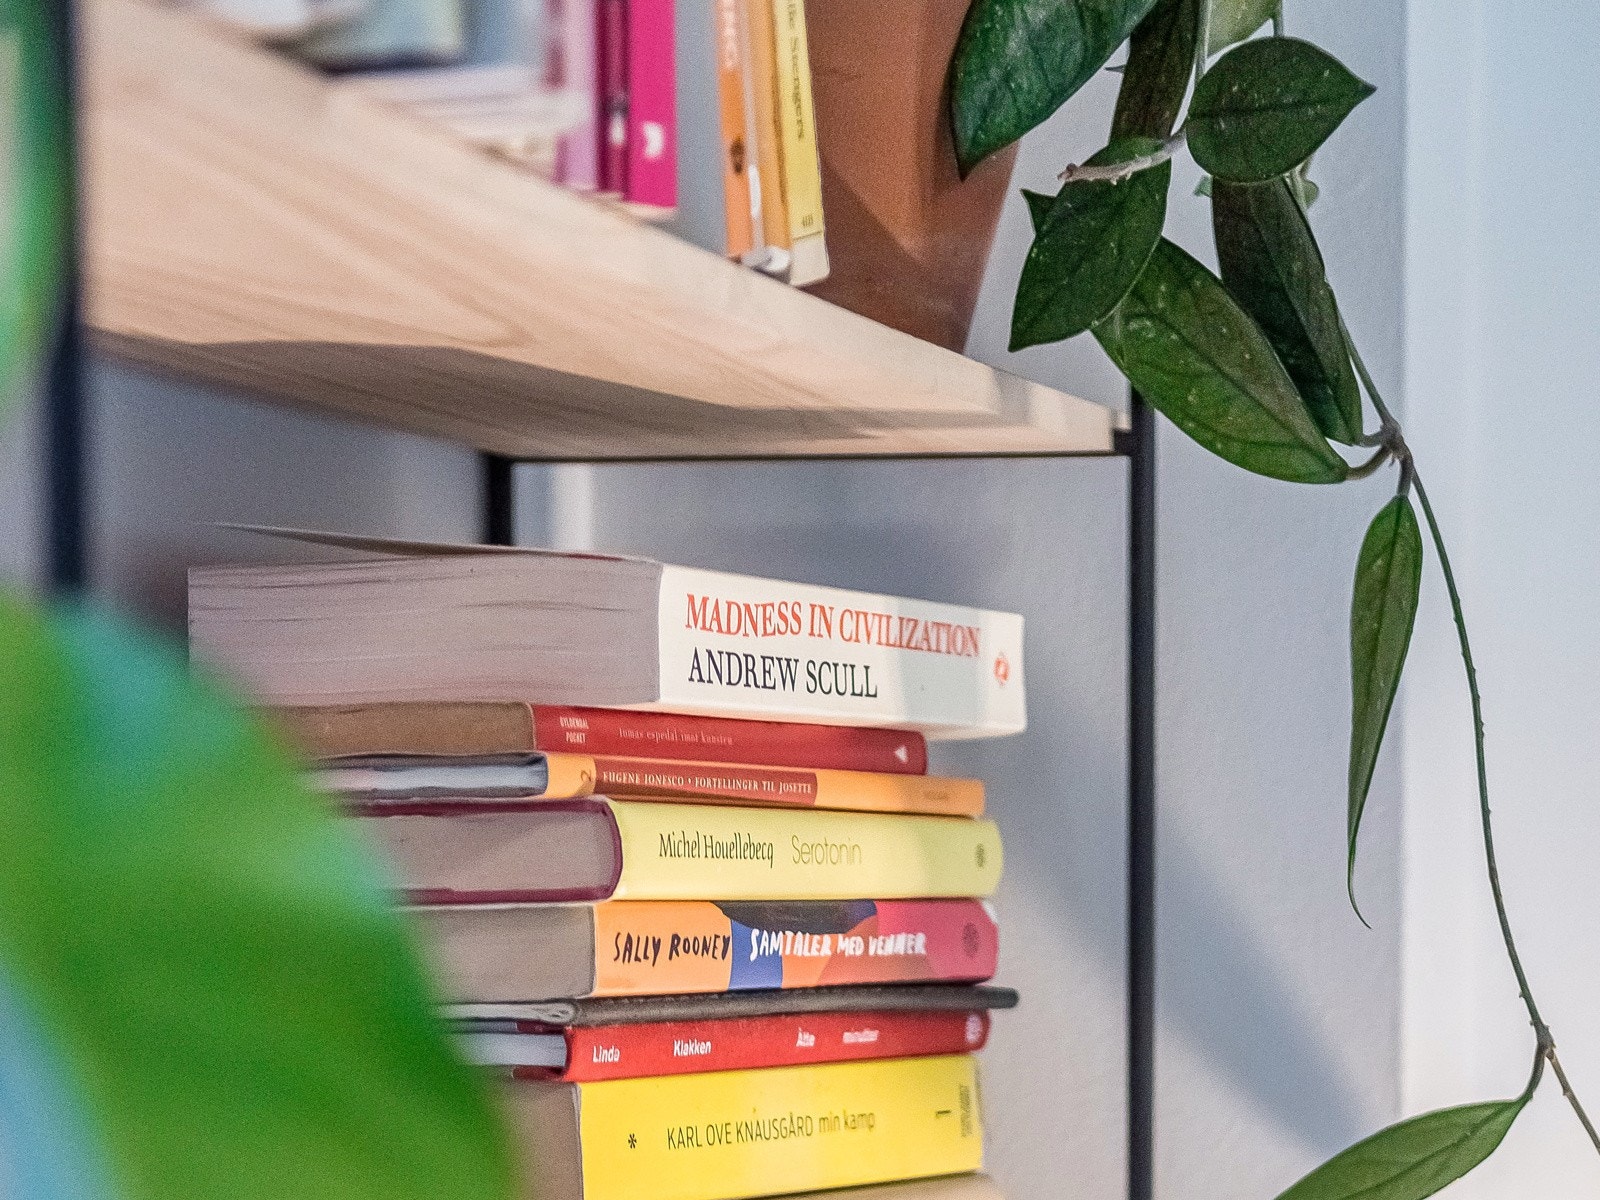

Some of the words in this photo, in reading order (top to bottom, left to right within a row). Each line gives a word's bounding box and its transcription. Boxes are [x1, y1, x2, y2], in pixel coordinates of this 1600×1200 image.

[685, 593, 802, 638] MADNESS
[808, 604, 835, 639] IN
[839, 608, 981, 657] CIVILIZATION
[688, 646, 800, 690] ANDREW
[805, 660, 878, 698] SCULL
[565, 731, 586, 744] POCKET
[603, 771, 640, 784] EUGENE
[644, 773, 685, 786] IONESCO
[695, 776, 759, 791] FORTELLINGER
[762, 780, 775, 792] TIL
[778, 781, 812, 795] JOSETTE
[659, 831, 700, 860] Michel
[703, 832, 774, 868] Houellebecq
[791, 835, 862, 866] Serotonin
[614, 932, 661, 967] SALLY
[668, 933, 731, 961] ROONEY
[749, 928, 832, 962] SAMTALER
[836, 933, 865, 957] MED
[868, 932, 927, 957] VENNER
[592, 1044, 620, 1063] Linda
[673, 1038, 712, 1057] Klakken
[667, 1126, 703, 1151] KARL
[706, 1122, 733, 1147] OVE
[736, 1111, 814, 1144] KNAUSGÅRD
[819, 1111, 841, 1133] min
[843, 1109, 876, 1132] kamp
